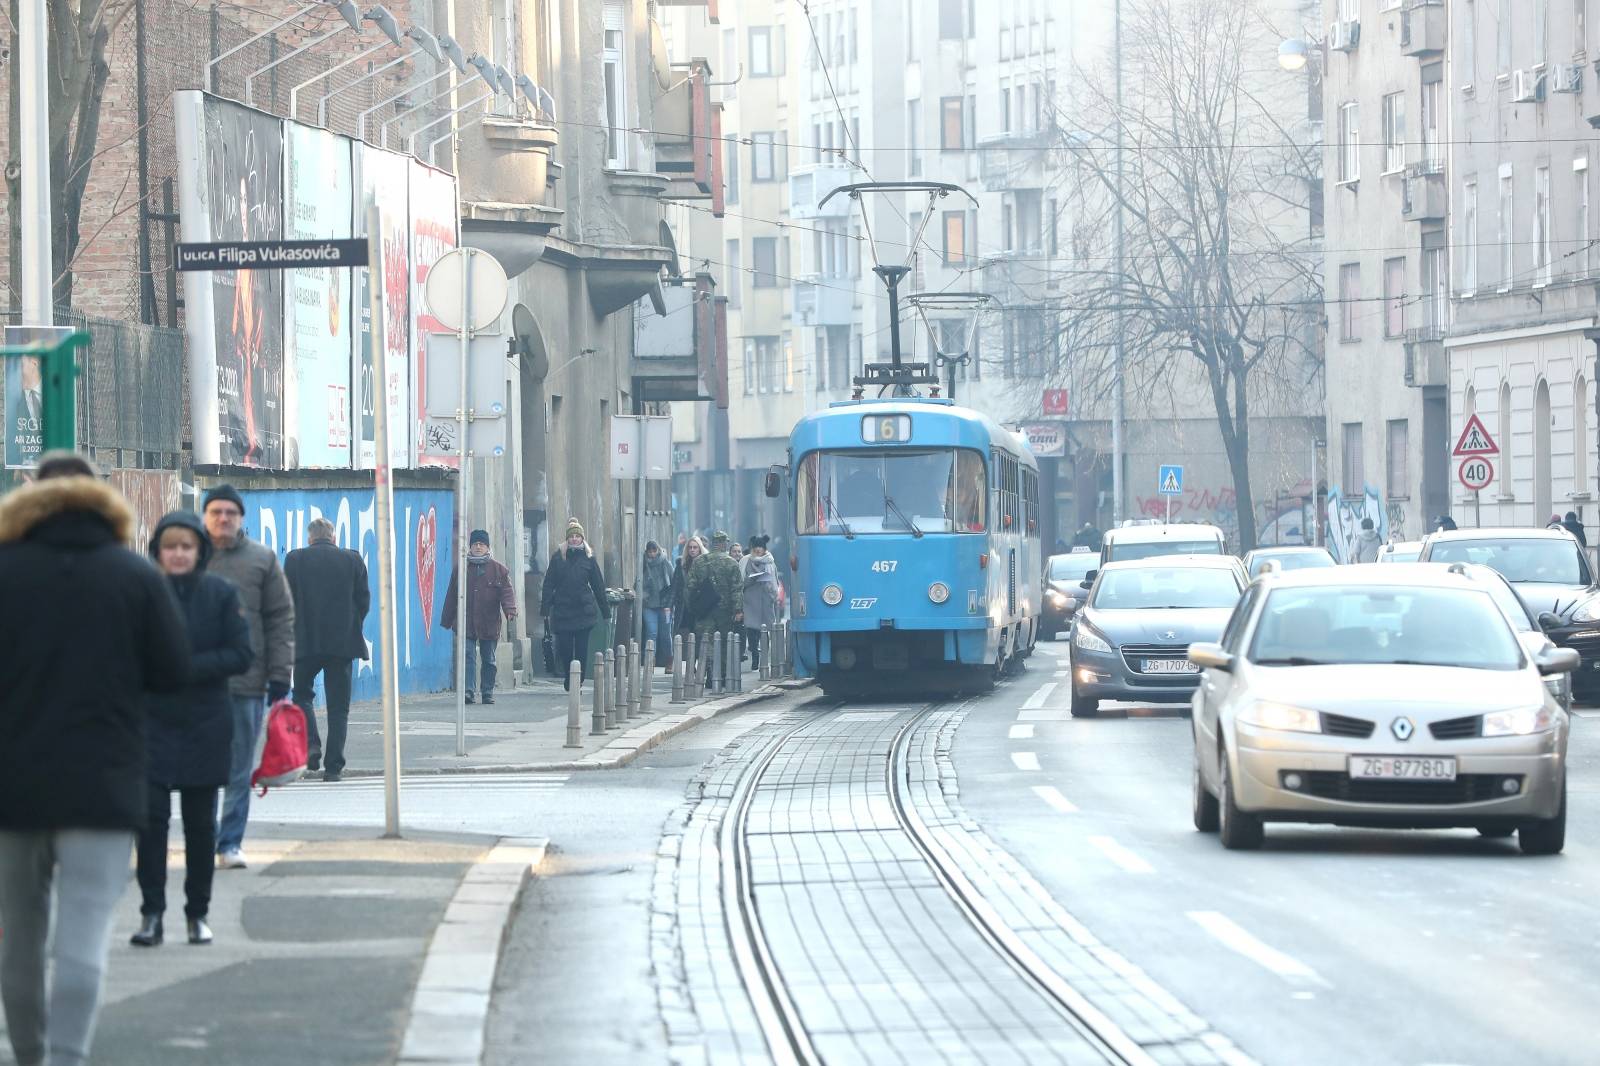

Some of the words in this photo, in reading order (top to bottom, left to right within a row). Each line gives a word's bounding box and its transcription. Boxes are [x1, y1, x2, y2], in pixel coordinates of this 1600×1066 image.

[183, 250, 216, 262] ULICA
[218, 247, 257, 265] Filipa
[259, 243, 341, 262] Vukasovića
[880, 418, 894, 439] 6
[1466, 464, 1486, 481] 40
[871, 560, 898, 573] 467
[850, 597, 878, 610] ZET
[1148, 660, 1160, 671] ZG
[1363, 760, 1382, 777] ZG
